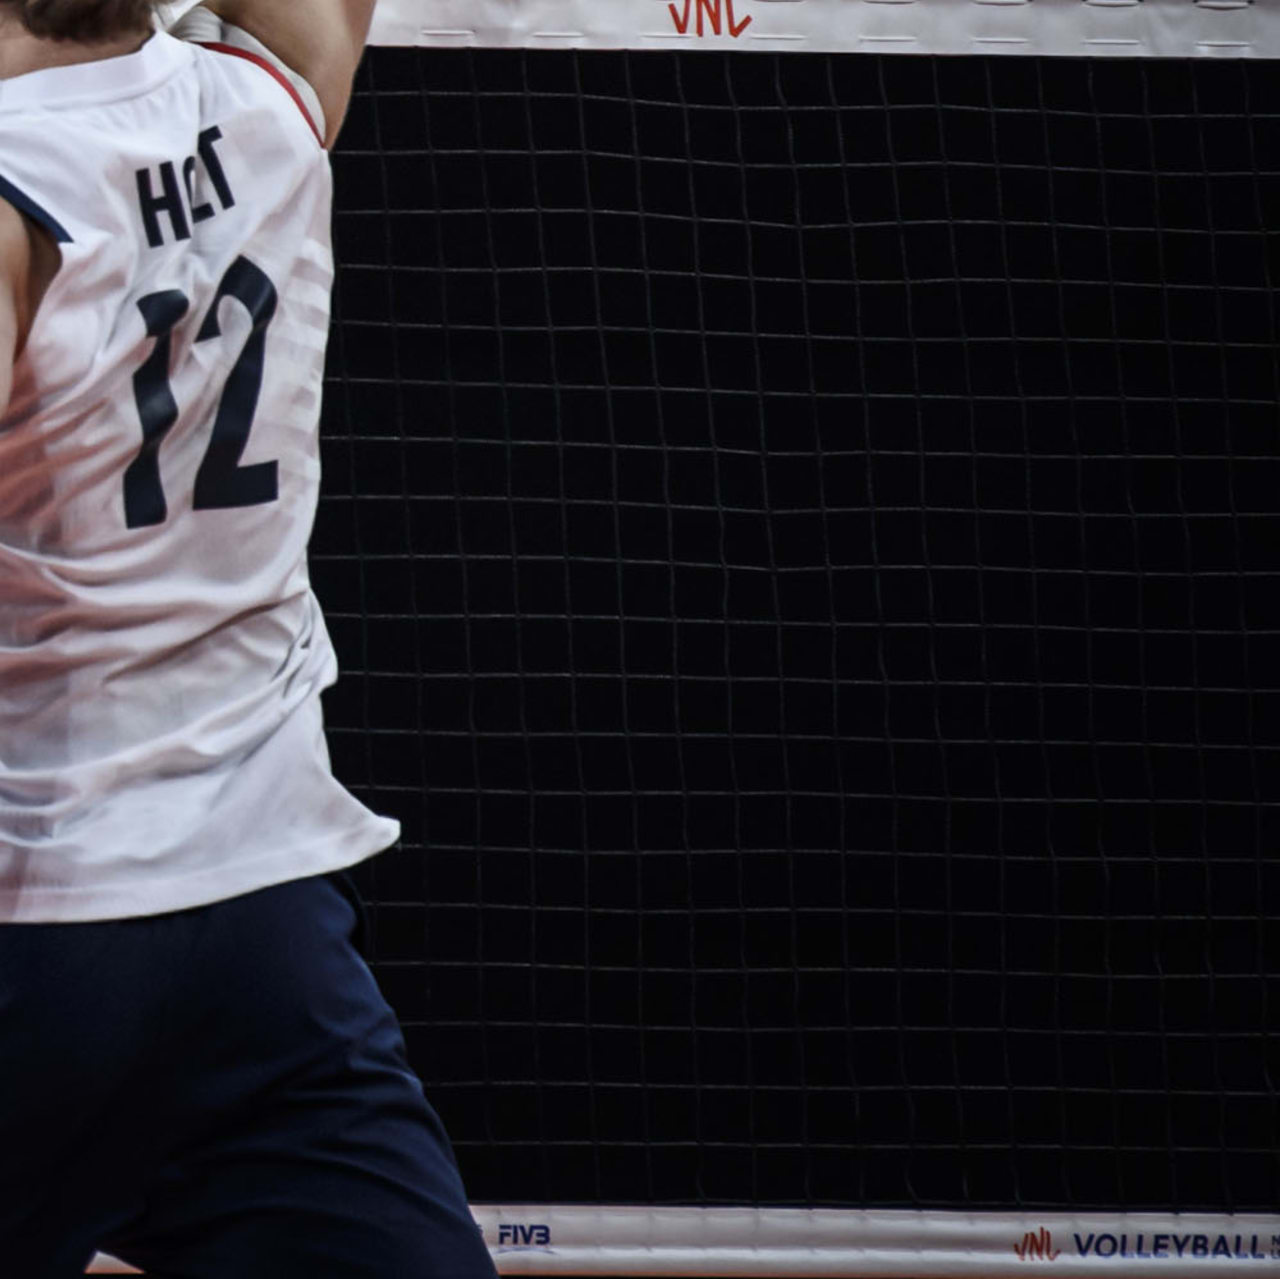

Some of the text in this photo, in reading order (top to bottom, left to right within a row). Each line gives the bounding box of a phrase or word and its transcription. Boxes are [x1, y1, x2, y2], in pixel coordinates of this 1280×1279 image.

[123, 253, 279, 530] 12
[498, 1224, 550, 1245] FIVB
[1013, 1226, 1062, 1262] VNL
[1072, 1233, 1266, 1259] VOLLEYBALL
